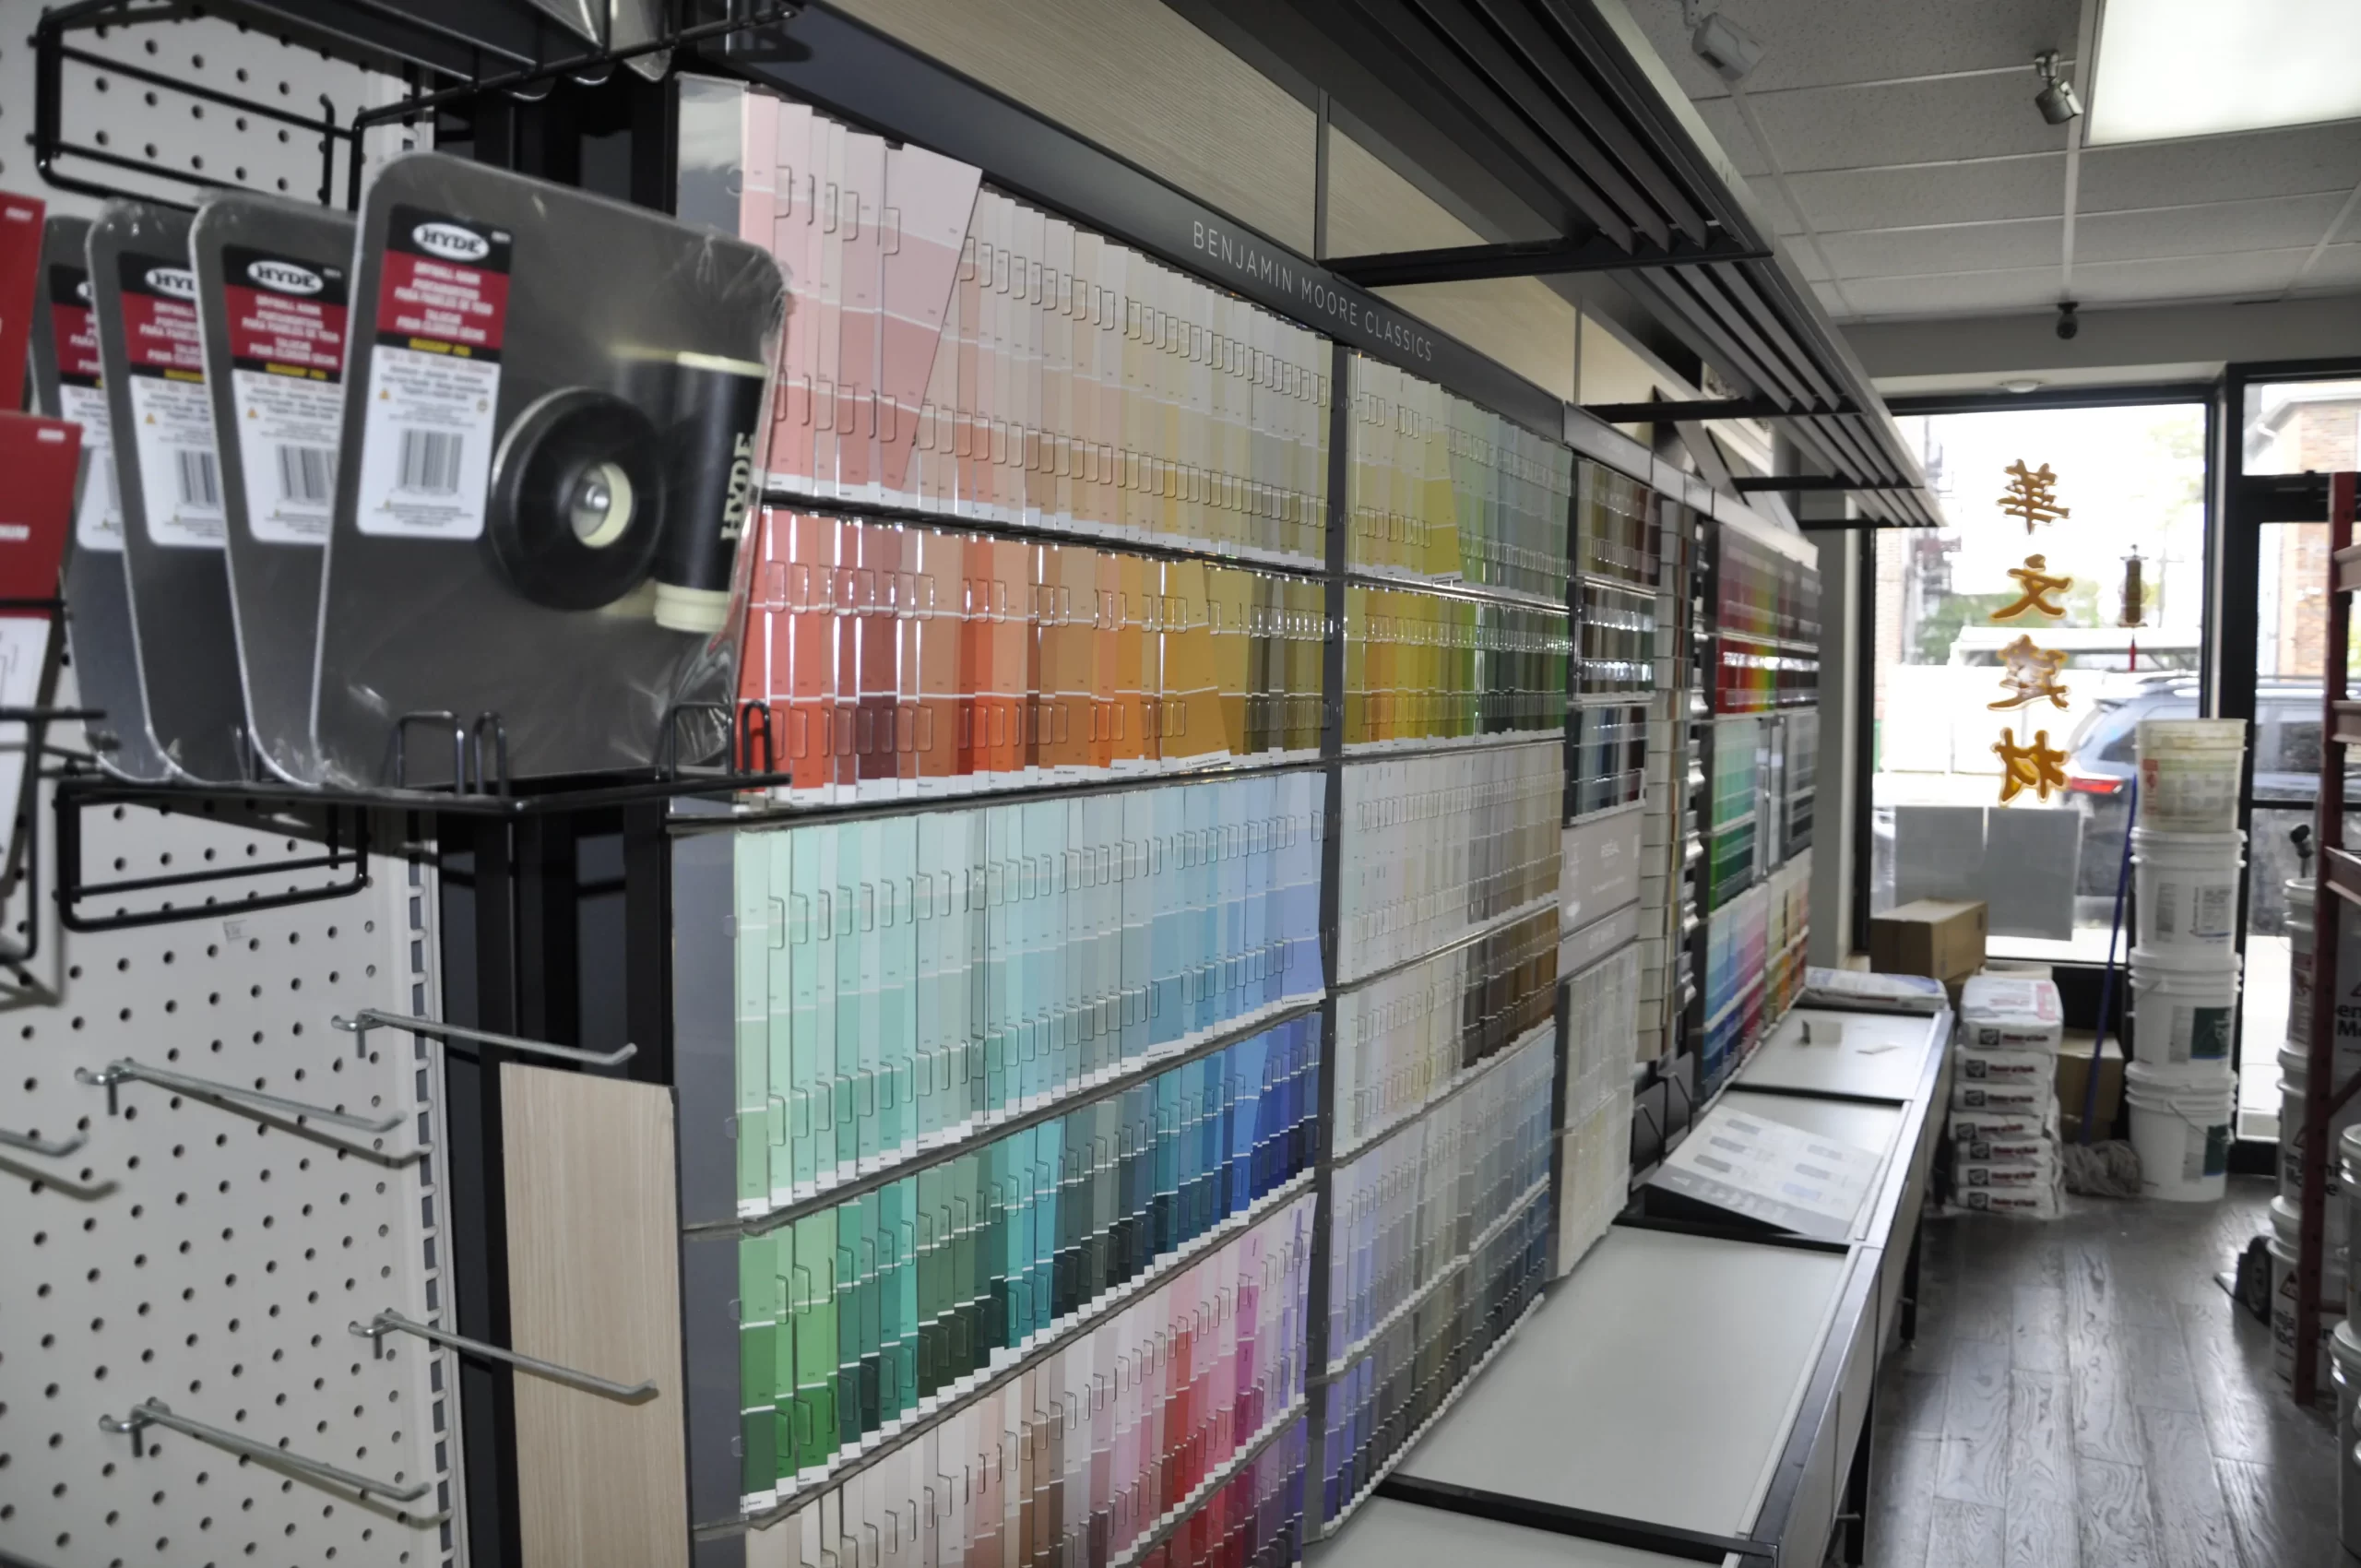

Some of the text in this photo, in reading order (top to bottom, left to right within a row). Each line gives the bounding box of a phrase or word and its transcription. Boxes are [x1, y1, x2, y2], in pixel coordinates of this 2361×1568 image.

[422, 226, 482, 255] HYDE
[256, 264, 318, 289] HYDE
[1193, 220, 1432, 362] BENJAMIN MOORE CLASSICS
[719, 432, 754, 540] HYDE
